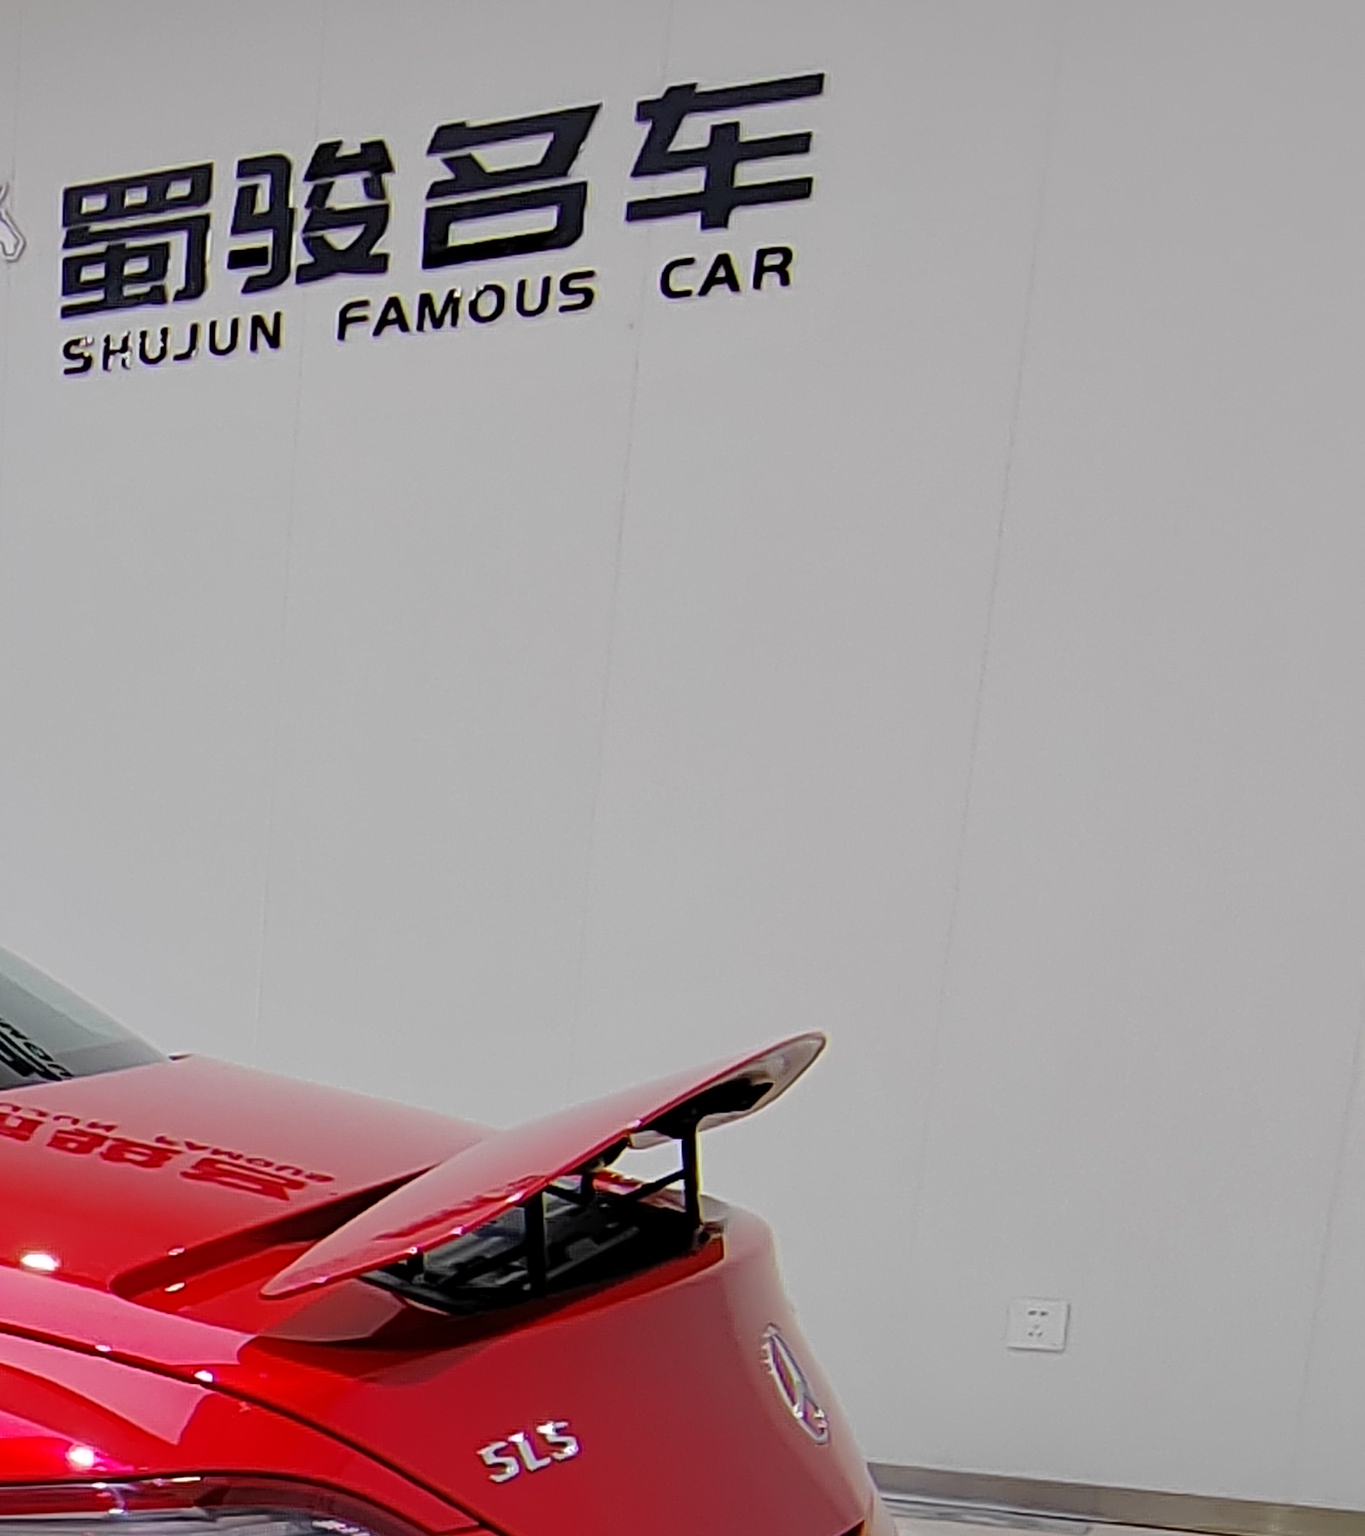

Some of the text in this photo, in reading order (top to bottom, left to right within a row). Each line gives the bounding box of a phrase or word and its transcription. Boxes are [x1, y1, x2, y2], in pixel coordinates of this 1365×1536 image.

[61, 73, 825, 319] 蜀骏名车
[62, 246, 794, 376] SHUJUN FAMOUS CAR
[476, 1420, 581, 1484] SLS
